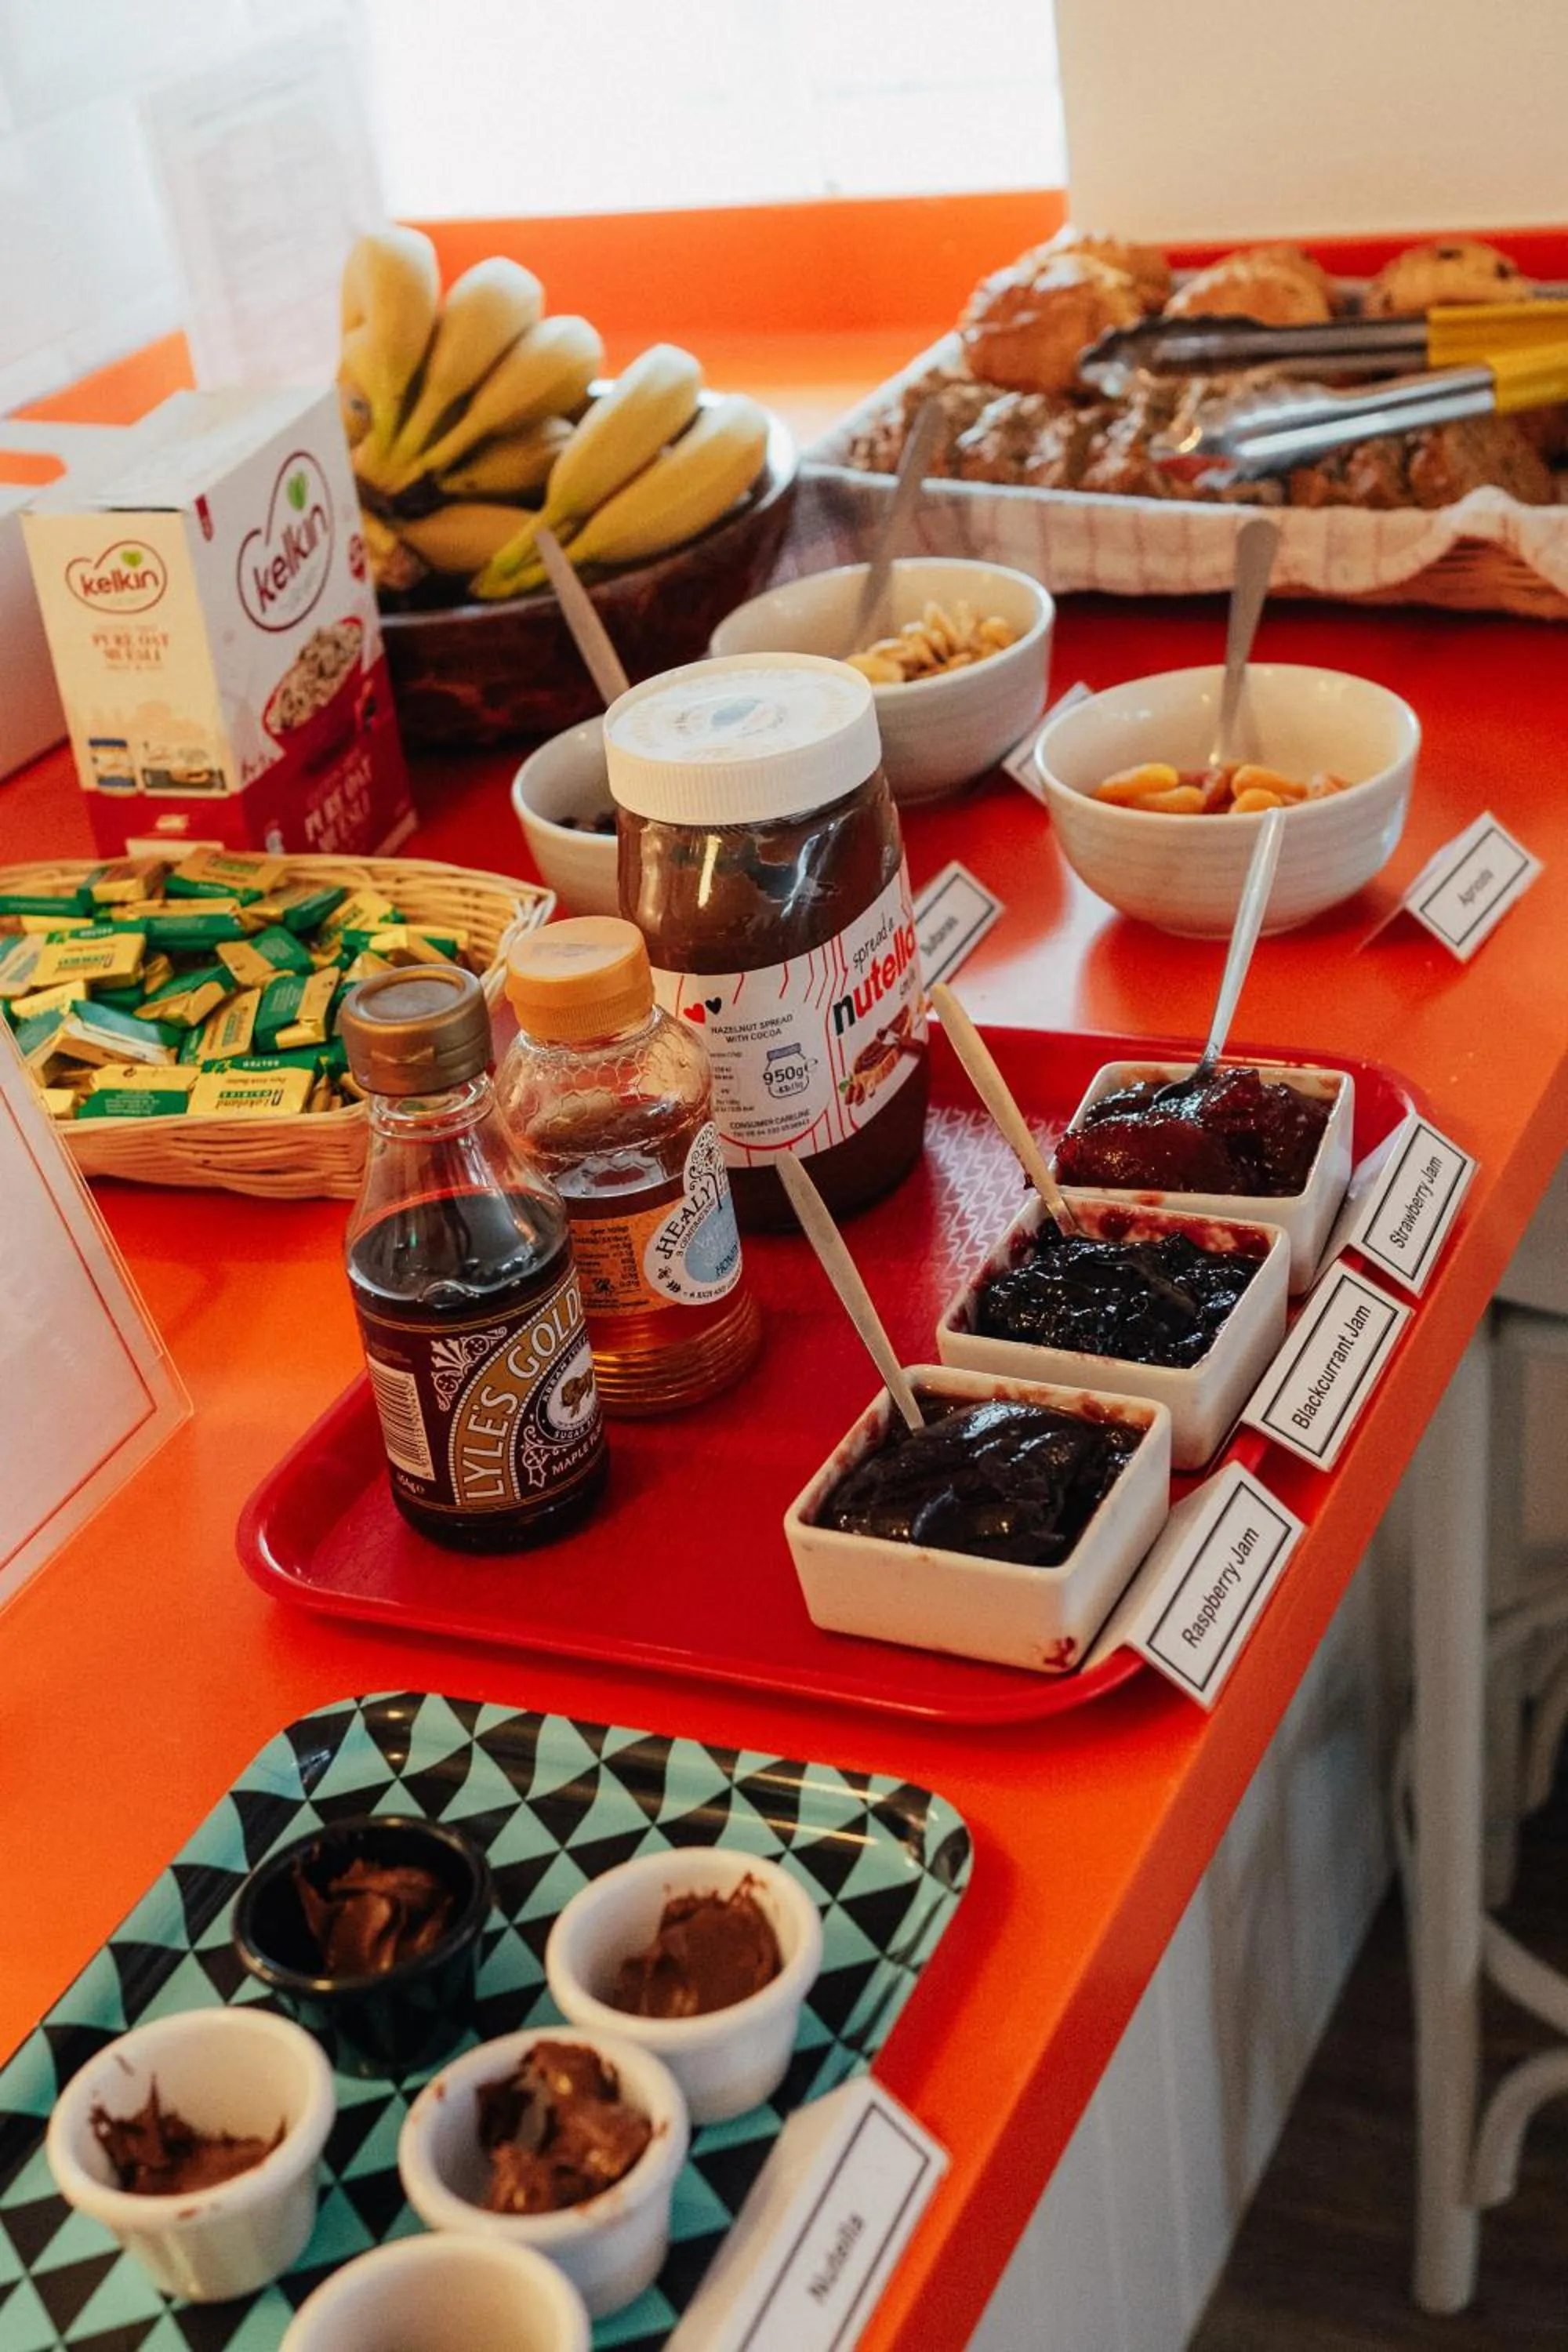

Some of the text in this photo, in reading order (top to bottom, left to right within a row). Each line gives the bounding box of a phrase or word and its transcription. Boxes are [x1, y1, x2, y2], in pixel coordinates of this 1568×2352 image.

[79, 568, 159, 597] kelkin
[252, 504, 328, 615] kelkin
[833, 919, 916, 1036] nutella
[853, 911, 888, 974] spread
[710, 1013, 793, 1035] HAZELNUT SPREAD
[725, 1028, 782, 1044] WITH COCOA
[763, 1065, 804, 1087] 950g
[655, 1180, 711, 1260] HEALY
[1390, 1156, 1443, 1250] Strawberry Jam
[461, 1279, 583, 1500] LYLE'S GOLD
[1292, 1305, 1371, 1430] Blackcurrant Jam
[552, 1444, 590, 1475] MAPLE
[554, 1425, 585, 1439] SUGAR
[1181, 1527, 1259, 1649] Raspberry Jam
[808, 2211, 865, 2307] Nutella
